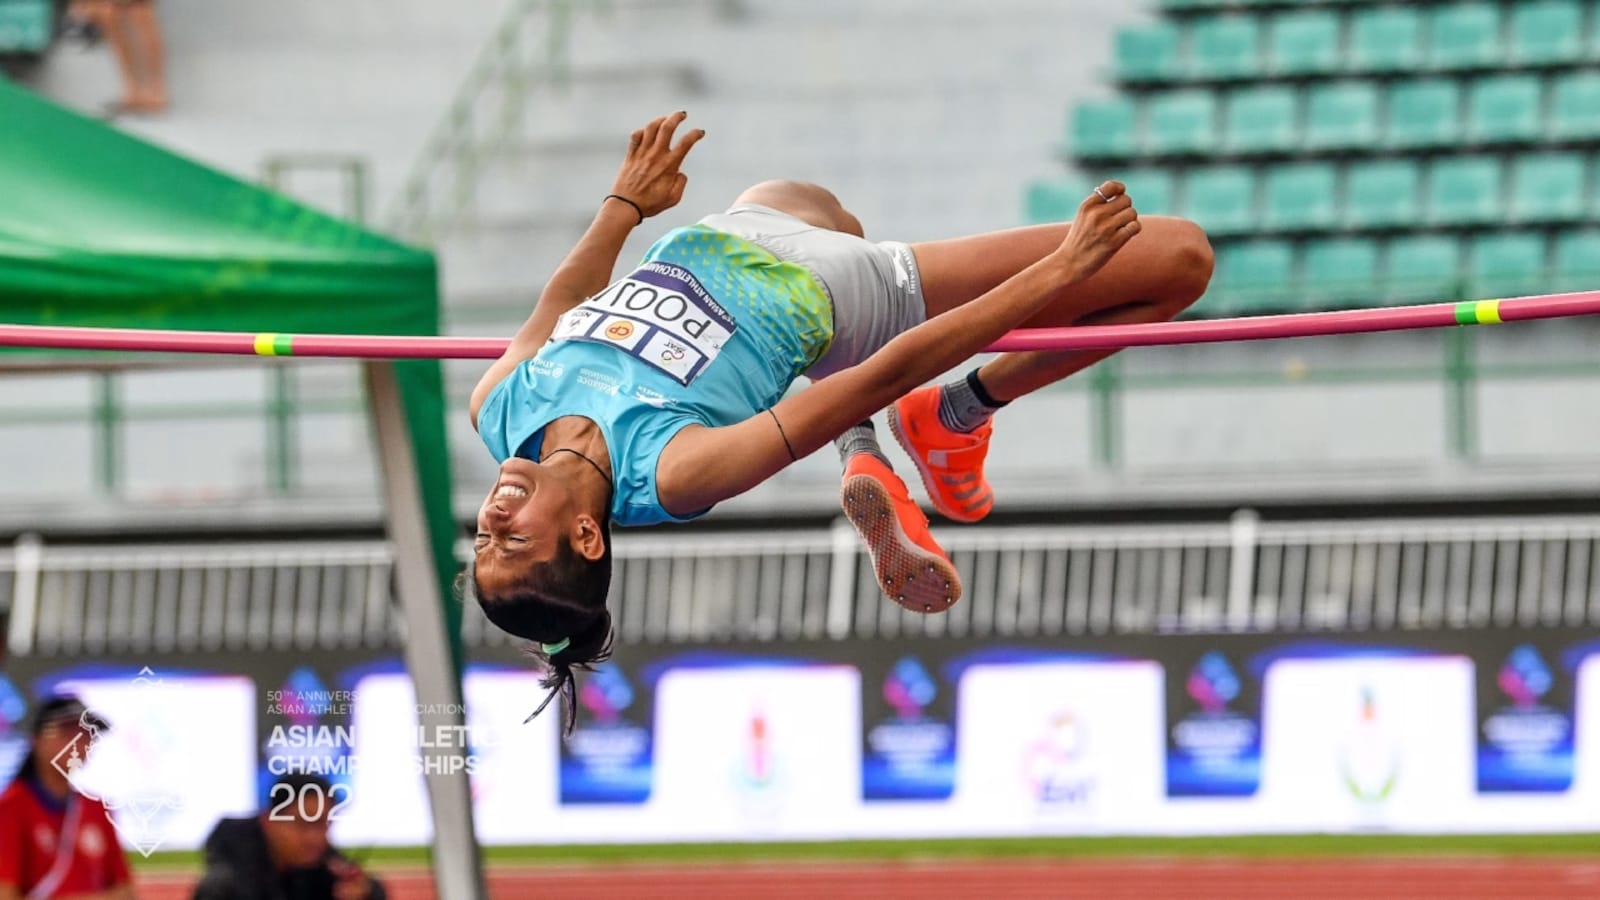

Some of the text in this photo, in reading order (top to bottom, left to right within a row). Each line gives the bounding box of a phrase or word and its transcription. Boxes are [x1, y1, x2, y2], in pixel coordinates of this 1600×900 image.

[669, 265, 706, 297] ATHLETICS
[702, 294, 727, 317] ASIAN
[609, 326, 631, 337] CP
